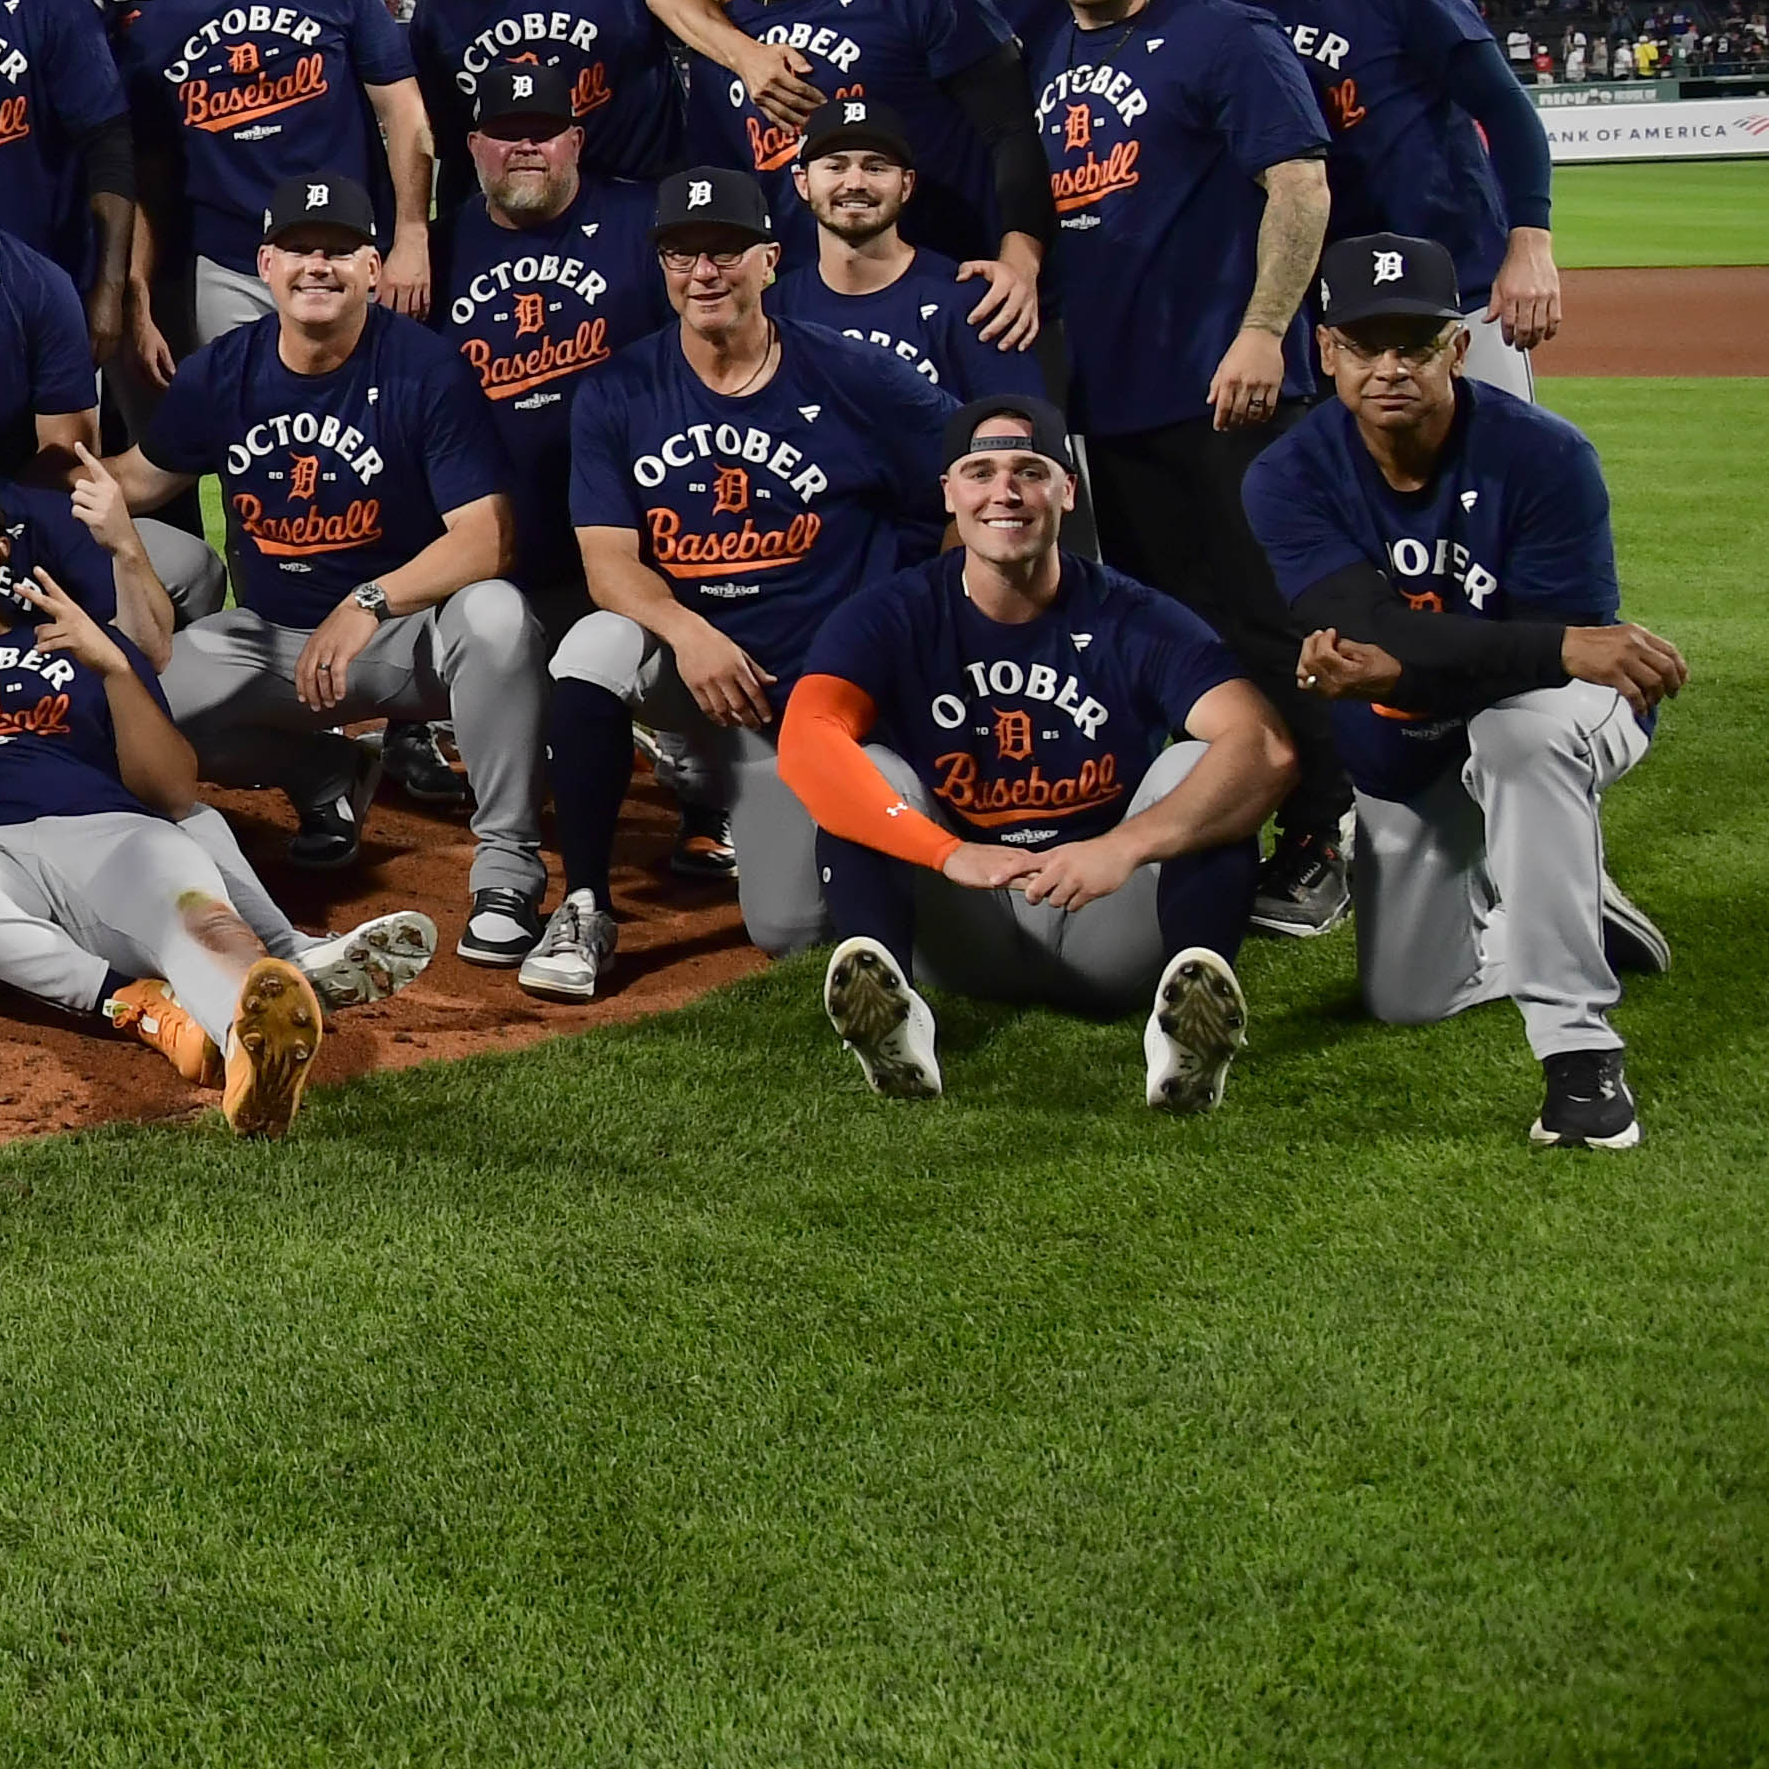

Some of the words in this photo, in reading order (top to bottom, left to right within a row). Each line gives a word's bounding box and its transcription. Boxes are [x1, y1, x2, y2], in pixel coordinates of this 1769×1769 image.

[163, 4, 323, 85] OCTOBER
[455, 11, 599, 97] OCTOBER
[178, 52, 330, 120] Baseball
[1596, 127, 1623, 142] OF
[1629, 125, 1728, 140] AMERICA
[450, 255, 608, 325] OCTOBER
[461, 317, 611, 388] Baseball
[227, 412, 385, 486] OCTOBER
[632, 423, 828, 505] OCTOBER
[233, 493, 383, 545] Baseball
[646, 507, 822, 561] Baseball
[700, 583, 760, 600] POSTSEASON
